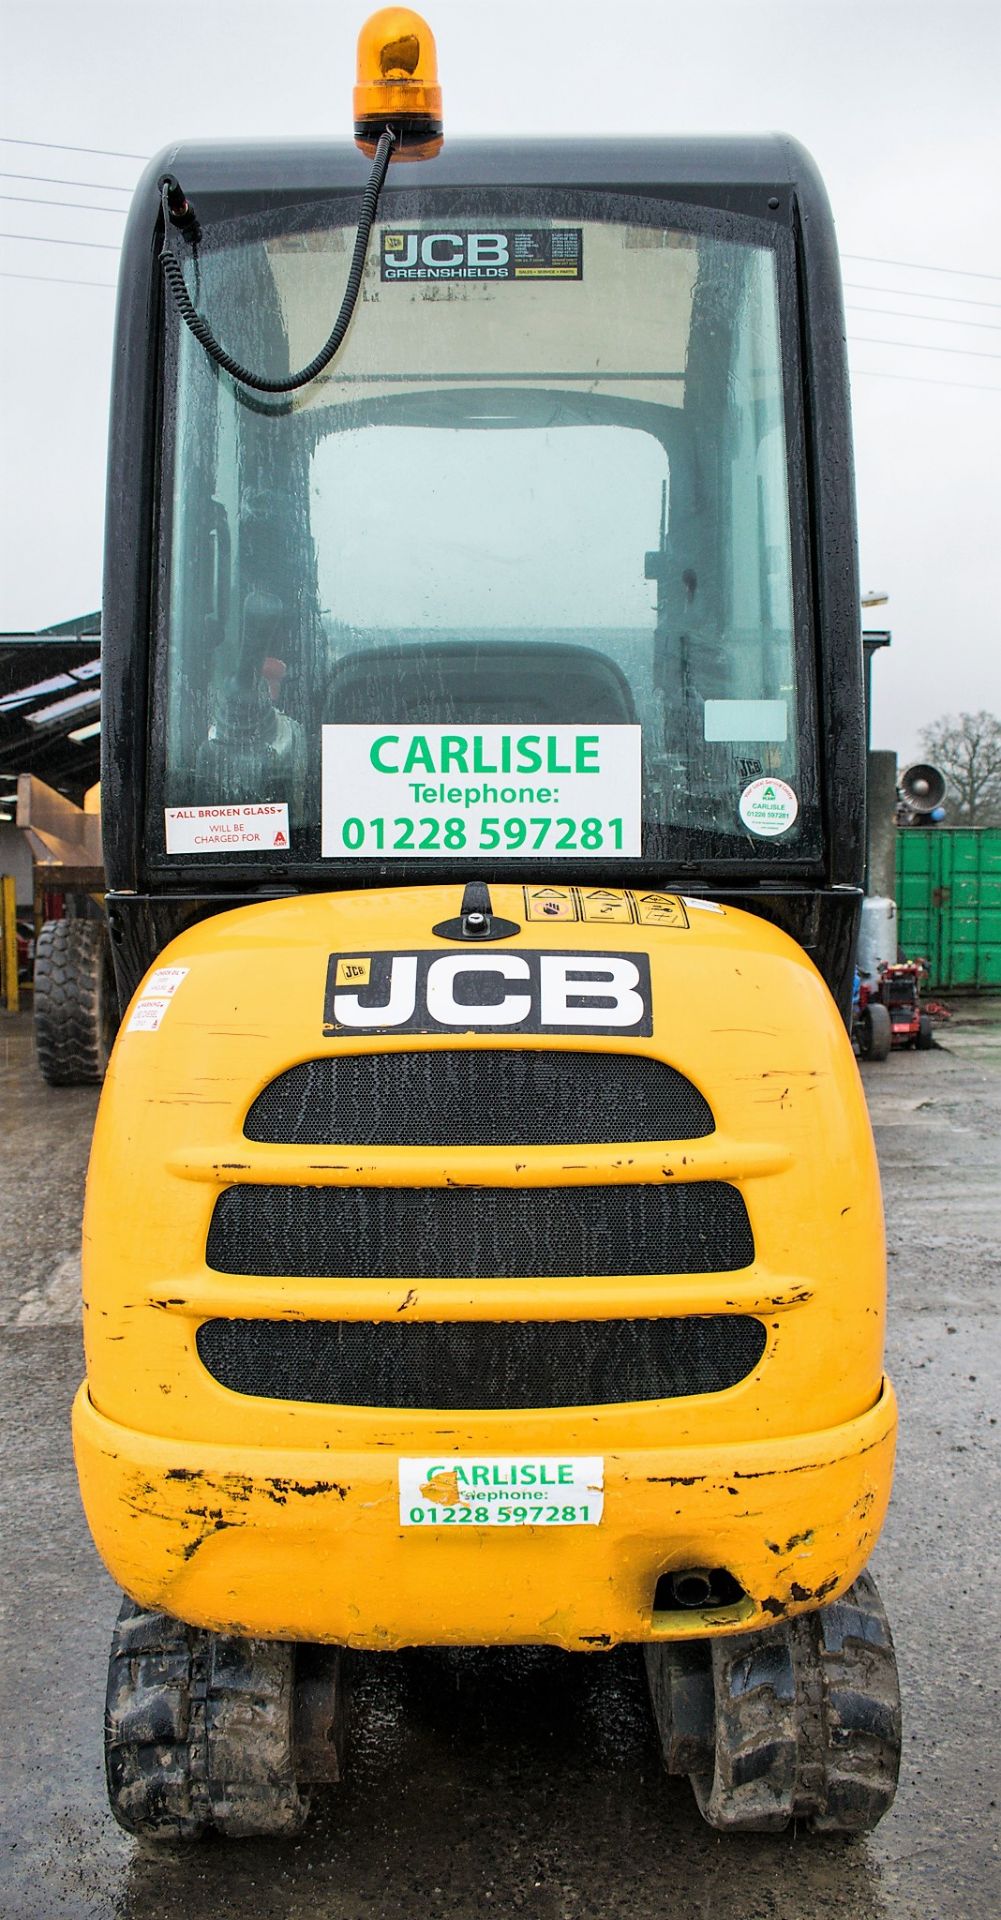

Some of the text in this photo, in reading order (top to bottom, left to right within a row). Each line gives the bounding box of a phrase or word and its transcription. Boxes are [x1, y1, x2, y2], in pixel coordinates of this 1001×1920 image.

[385, 234, 510, 267] JCB
[385, 268, 508, 278] GREENSHIELDS
[369, 735, 600, 774] CARLISLE
[409, 783, 559, 808] Telephone:
[176, 807, 276, 819] ALL BROKEN GLASS
[752, 803, 785, 811] CARLISLE
[209, 824, 245, 833] WILL BE
[342, 817, 623, 850] 01228 597281
[194, 834, 260, 844] CHARGED FOR
[345, 965, 365, 979] JCB
[333, 954, 645, 1027] JCB
[410, 1505, 589, 1524] 01228 597281
